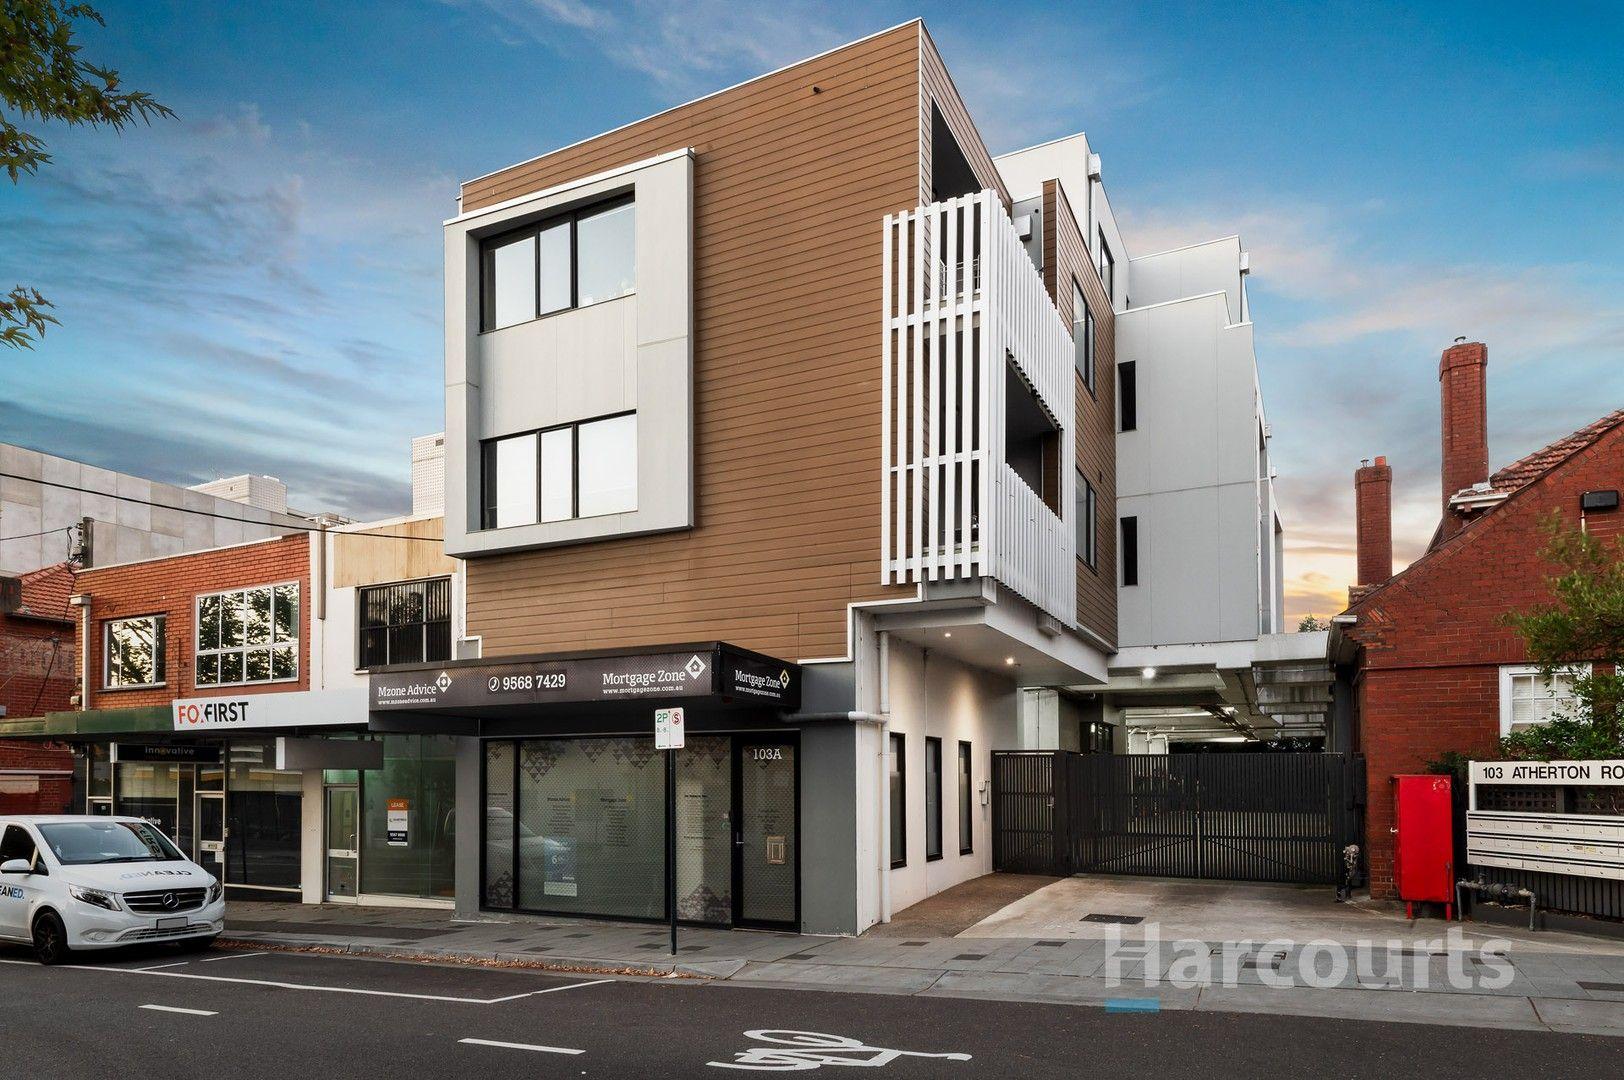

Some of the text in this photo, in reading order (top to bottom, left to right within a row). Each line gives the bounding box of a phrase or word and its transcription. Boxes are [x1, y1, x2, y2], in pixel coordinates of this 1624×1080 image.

[502, 673, 566, 691] 9568 7429
[602, 670, 686, 687] Mortgage Zone
[735, 669, 780, 689] Mortgage Zone
[378, 683, 437, 697] Mzone Advice
[656, 712, 669, 723] 2P
[753, 748, 782, 760] 103A
[1483, 765, 1624, 780] 103 ATHERTON RO
